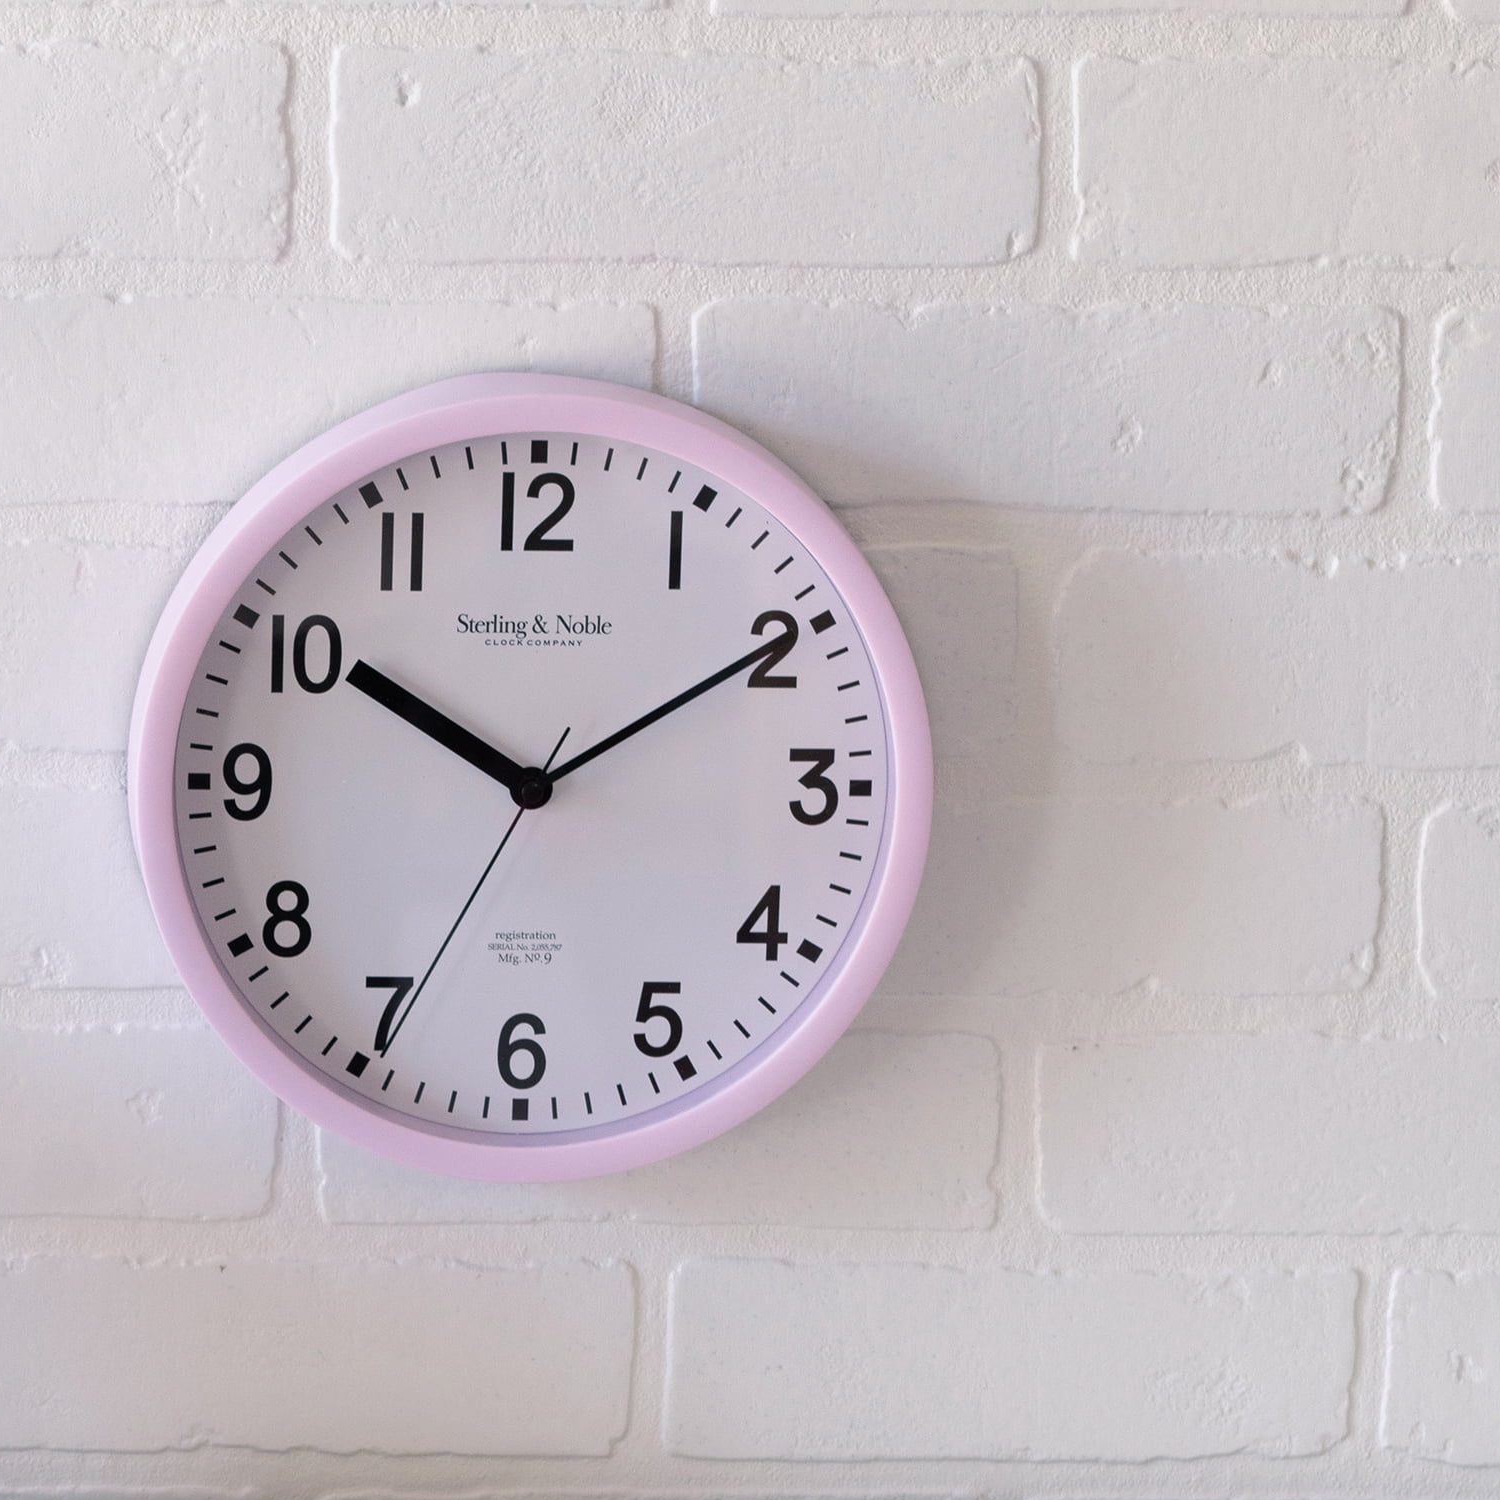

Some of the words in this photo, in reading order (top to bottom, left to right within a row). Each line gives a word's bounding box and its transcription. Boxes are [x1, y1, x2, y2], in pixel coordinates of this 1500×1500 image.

[500, 471, 576, 552] 12
[668, 510, 684, 591] 1
[379, 511, 425, 592] 11
[270, 614, 343, 695] 10
[456, 613, 529, 640] Sterling
[531, 614, 549, 635] &
[555, 614, 613, 635] Noble
[484, 639, 524, 647] CLOCK
[526, 639, 583, 647] COMPANY
[746, 609, 800, 689] 2
[222, 742, 274, 822] 9
[788, 747, 840, 826] 3
[261, 879, 313, 959] 8
[487, 943, 516, 951] SERIAL
[495, 930, 557, 942] registration
[735, 884, 789, 962] 4
[498, 953, 521, 966] Mfg.
[364, 975, 415, 1053] 7
[496, 1012, 548, 1090] 6
[633, 981, 684, 1058] 5
